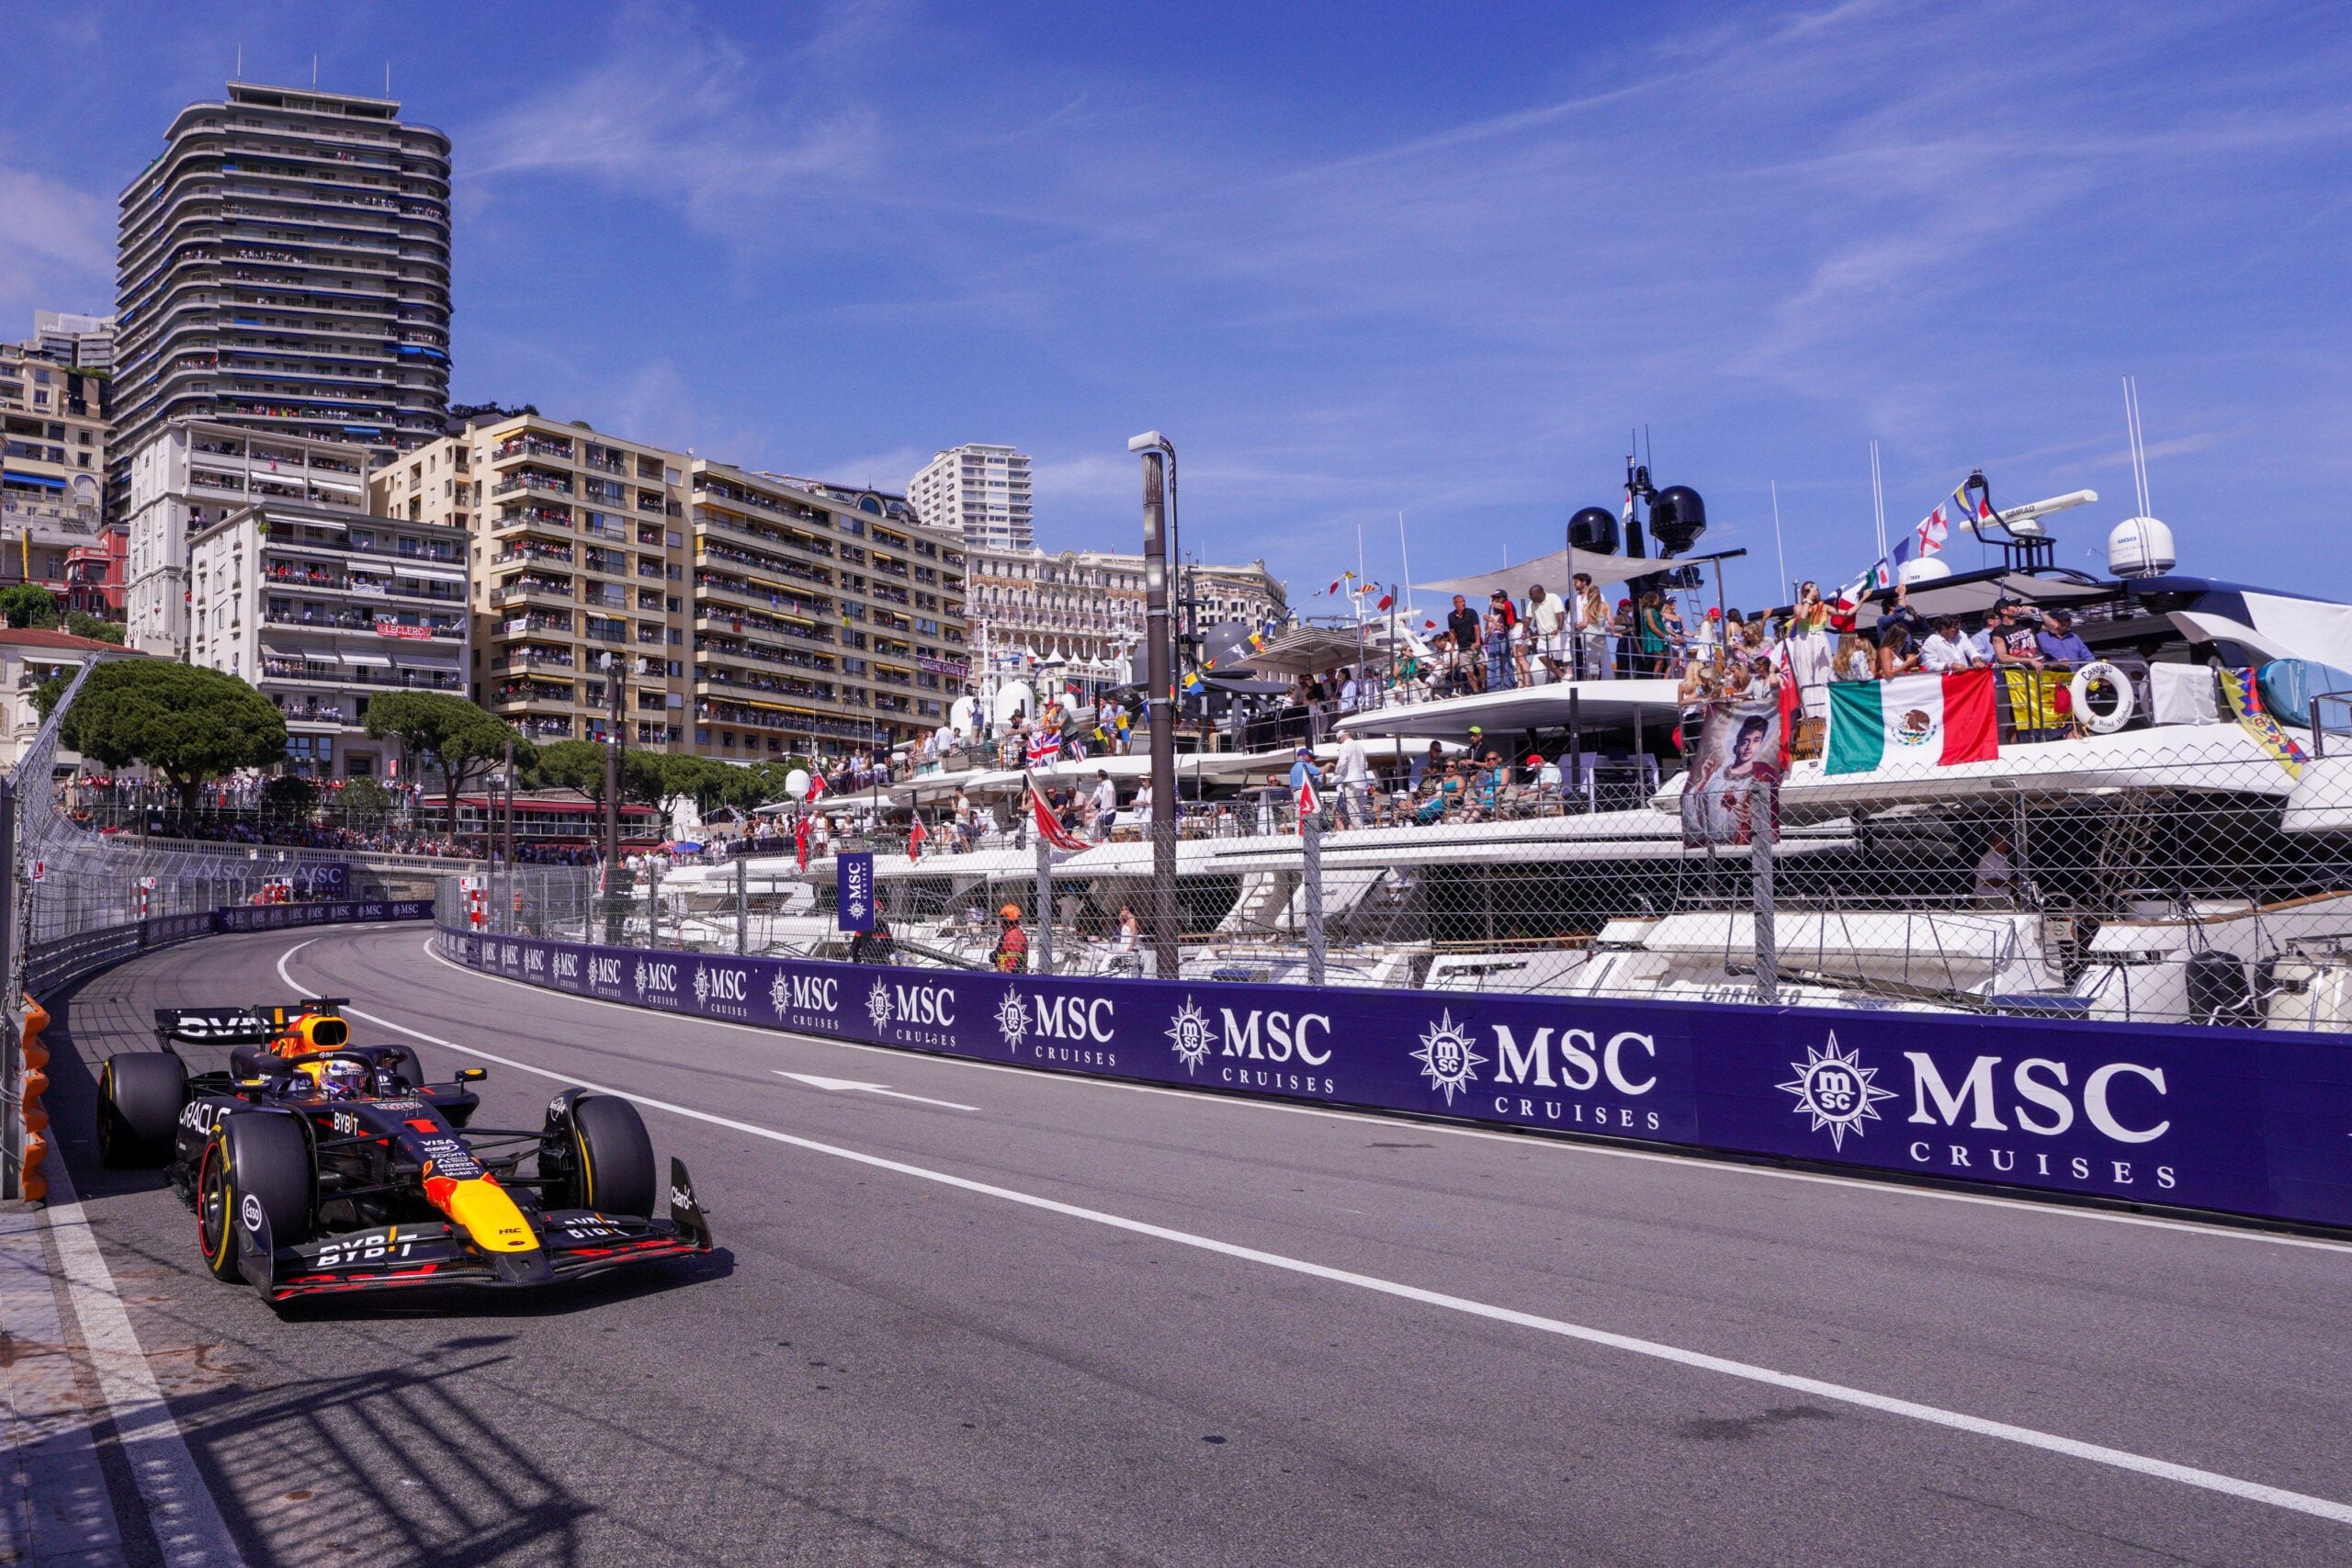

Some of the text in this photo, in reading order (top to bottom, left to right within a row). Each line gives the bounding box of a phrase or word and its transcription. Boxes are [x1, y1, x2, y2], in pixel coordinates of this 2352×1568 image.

[2005, 505, 2035, 519] SIMRAD
[386, 626, 424, 636] LECLERC
[300, 867, 342, 884] MSC
[848, 863, 862, 899] MSC
[336, 906, 350, 916] MSC
[366, 905, 382, 915] MSC
[401, 904, 419, 914] MSC
[486, 942, 495, 961] MSC
[506, 944, 518, 964] MSC
[530, 949, 545, 971] MSC
[560, 953, 578, 977] MSC
[598, 957, 621, 984] MSC
[649, 963, 677, 992] MSC
[710, 968, 747, 1001] MSC
[598, 987, 621, 998] CRUISES
[648, 994, 678, 1007] CRUISES
[793, 975, 838, 1012] MSC
[711, 1003, 747, 1017] CRUISES
[896, 985, 956, 1026] MSC
[793, 1014, 839, 1030] CRUISES
[1034, 995, 1114, 1043] MSC
[1219, 1008, 1331, 1066] MSC
[1035, 1045, 1115, 1066] CRUISES
[1491, 1024, 1657, 1095] MSC
[1222, 1067, 1334, 1094] CRUISES
[1904, 1051, 2170, 1144] MSC
[334, 1111, 359, 1136] BYBIT
[1494, 1097, 1659, 1130] CRUISES
[1909, 1141, 2177, 1190] CRUISES
[671, 1185, 691, 1210] Claro
[245, 1201, 260, 1221] Esso
[316, 1226, 418, 1267] BYBIT
